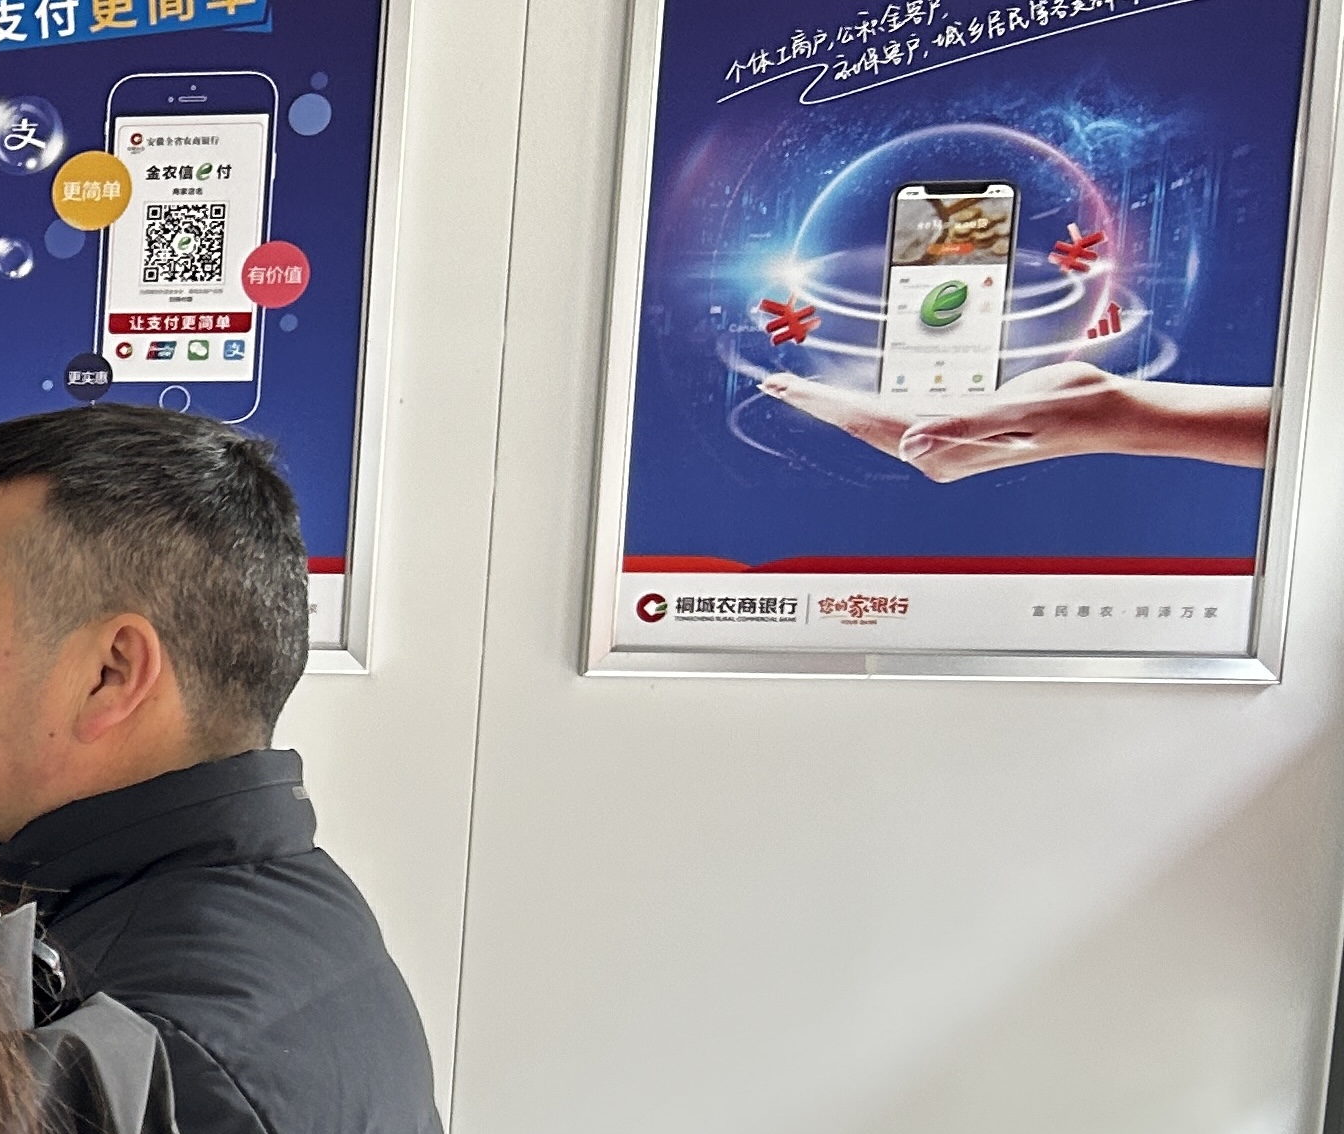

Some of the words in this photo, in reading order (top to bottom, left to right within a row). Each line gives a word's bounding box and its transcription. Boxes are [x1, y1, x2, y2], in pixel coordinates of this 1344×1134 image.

[62, 180, 122, 203] 更简单
[248, 265, 303, 285] 有价值
[129, 314, 231, 331] 让支付更简单
[67, 370, 110, 386] 更实惠
[675, 596, 798, 615] 桐城农商银行
[818, 594, 910, 619] 您的家银行
